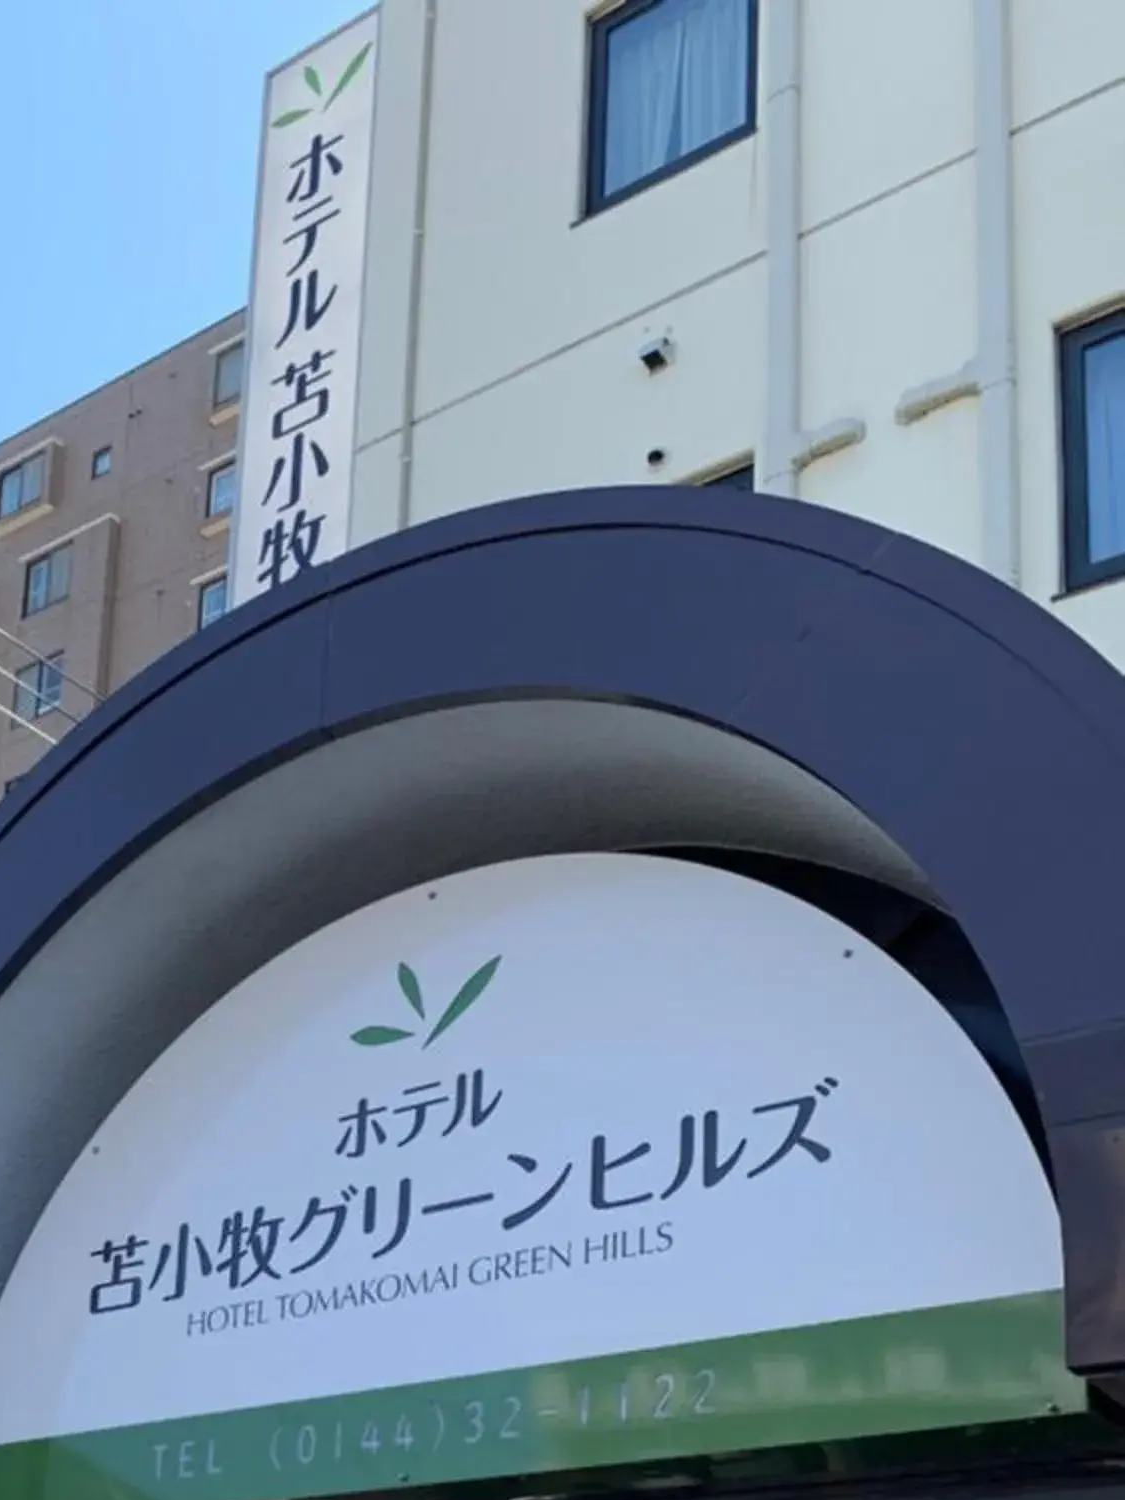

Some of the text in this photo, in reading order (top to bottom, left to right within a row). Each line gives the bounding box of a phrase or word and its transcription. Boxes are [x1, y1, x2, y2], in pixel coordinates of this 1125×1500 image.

[336, 1069, 503, 1158] ホテル
[89, 1077, 839, 1315] 苫小牧グリーンヒルズ
[186, 1222, 674, 1337] HOTEL TOMAKOMAI GREEN HILLS
[153, 1439, 222, 1479] TEL
